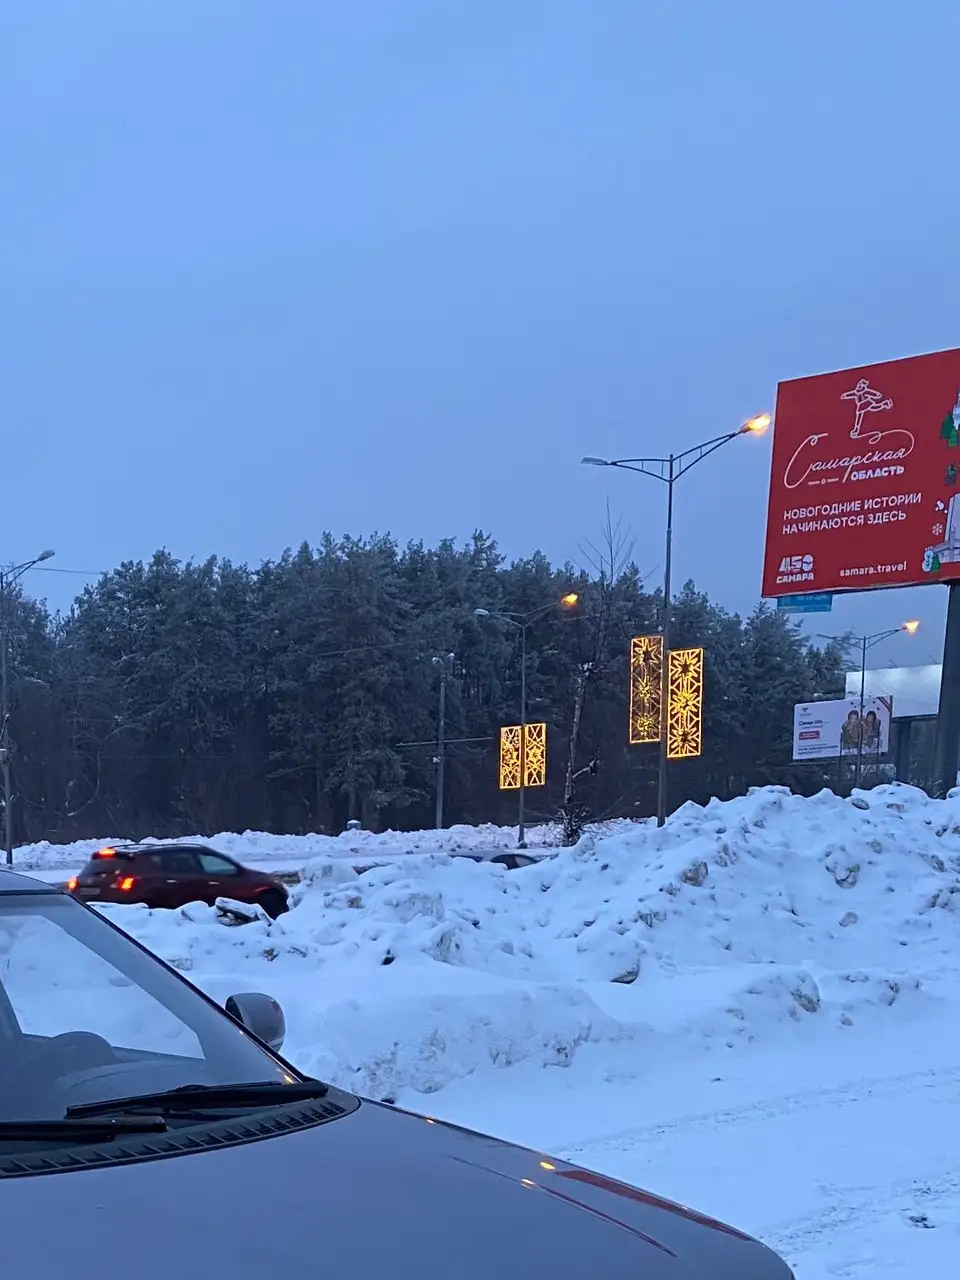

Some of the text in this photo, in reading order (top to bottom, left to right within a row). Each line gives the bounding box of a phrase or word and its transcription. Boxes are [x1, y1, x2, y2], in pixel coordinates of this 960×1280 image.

[784, 429, 914, 488] Самарская
[850, 465, 905, 481] ОБЛАСТЬ
[783, 492, 922, 521] НОВОГОДНИЕ ИСТОРИИ
[782, 510, 907, 535] НАЧИНАЮТСЯ ЗДЕСЬ
[776, 572, 815, 584] САМАРА
[840, 560, 907, 577] samara.travel
